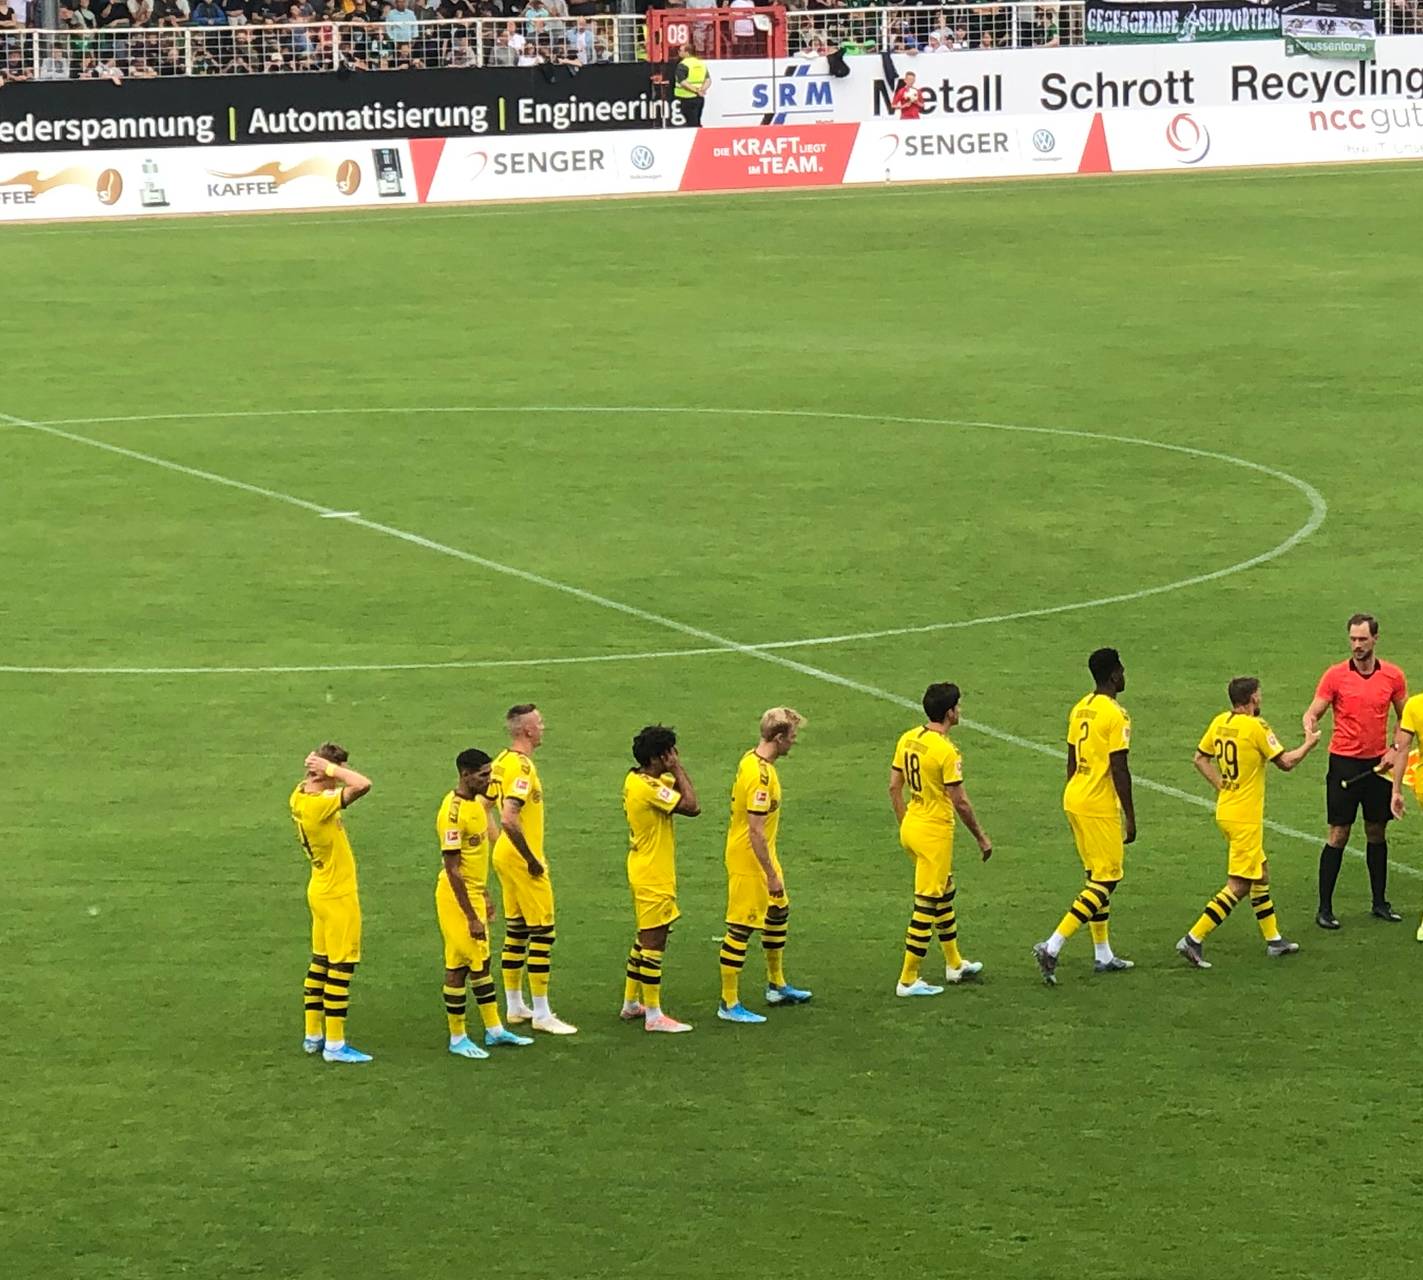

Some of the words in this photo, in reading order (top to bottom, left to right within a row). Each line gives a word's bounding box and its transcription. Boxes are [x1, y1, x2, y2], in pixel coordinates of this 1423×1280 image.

[1199, 6, 1279, 32] SUPPORTERS
[667, 23, 688, 44] 08
[1040, 69, 1195, 110] Schrott
[248, 101, 488, 134] Automatisierung
[518, 93, 687, 129] Engineering
[713, 147, 730, 157] DIE
[732, 137, 800, 156] KRAFT
[799, 143, 827, 154] LIEGT
[905, 132, 1009, 157] SENGER
[493, 149, 605, 175] SENGER
[759, 156, 824, 175] TEAM.
[207, 181, 279, 197] KAFFEE
[904, 751, 922, 792] 18
[1214, 738, 1239, 780] 29
